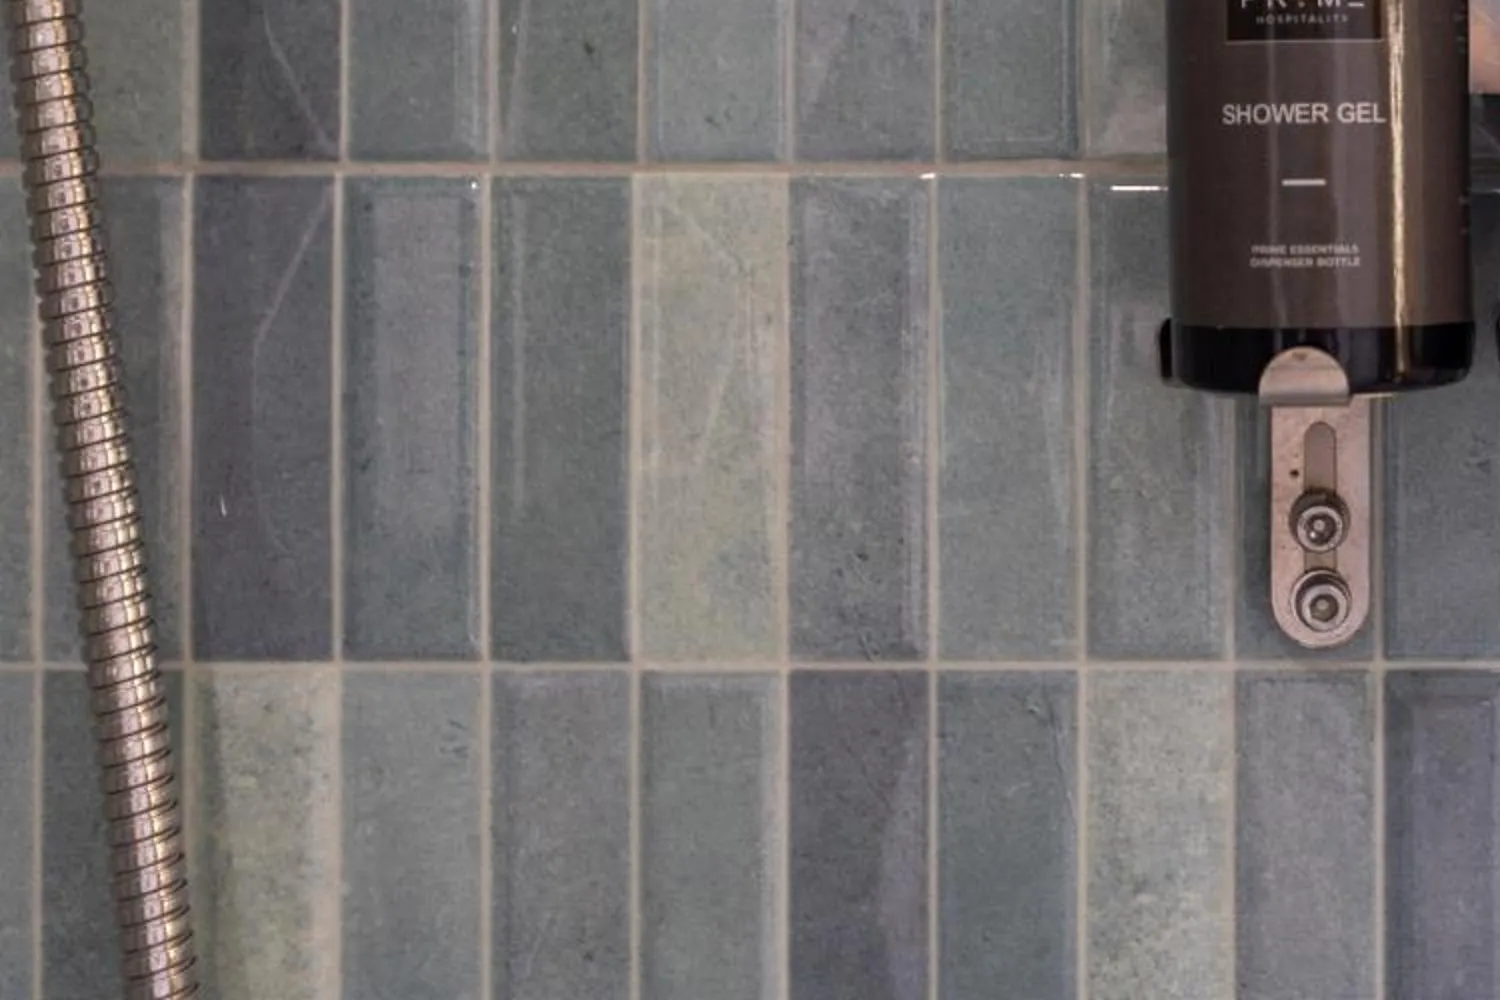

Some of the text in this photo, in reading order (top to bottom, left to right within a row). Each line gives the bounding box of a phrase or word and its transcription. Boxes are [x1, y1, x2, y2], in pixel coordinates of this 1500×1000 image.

[1256, 14, 1349, 25] HOSPITALITY
[1222, 102, 1387, 125] SHOWER GEL
[1316, 256, 1361, 268] BOTTLE
